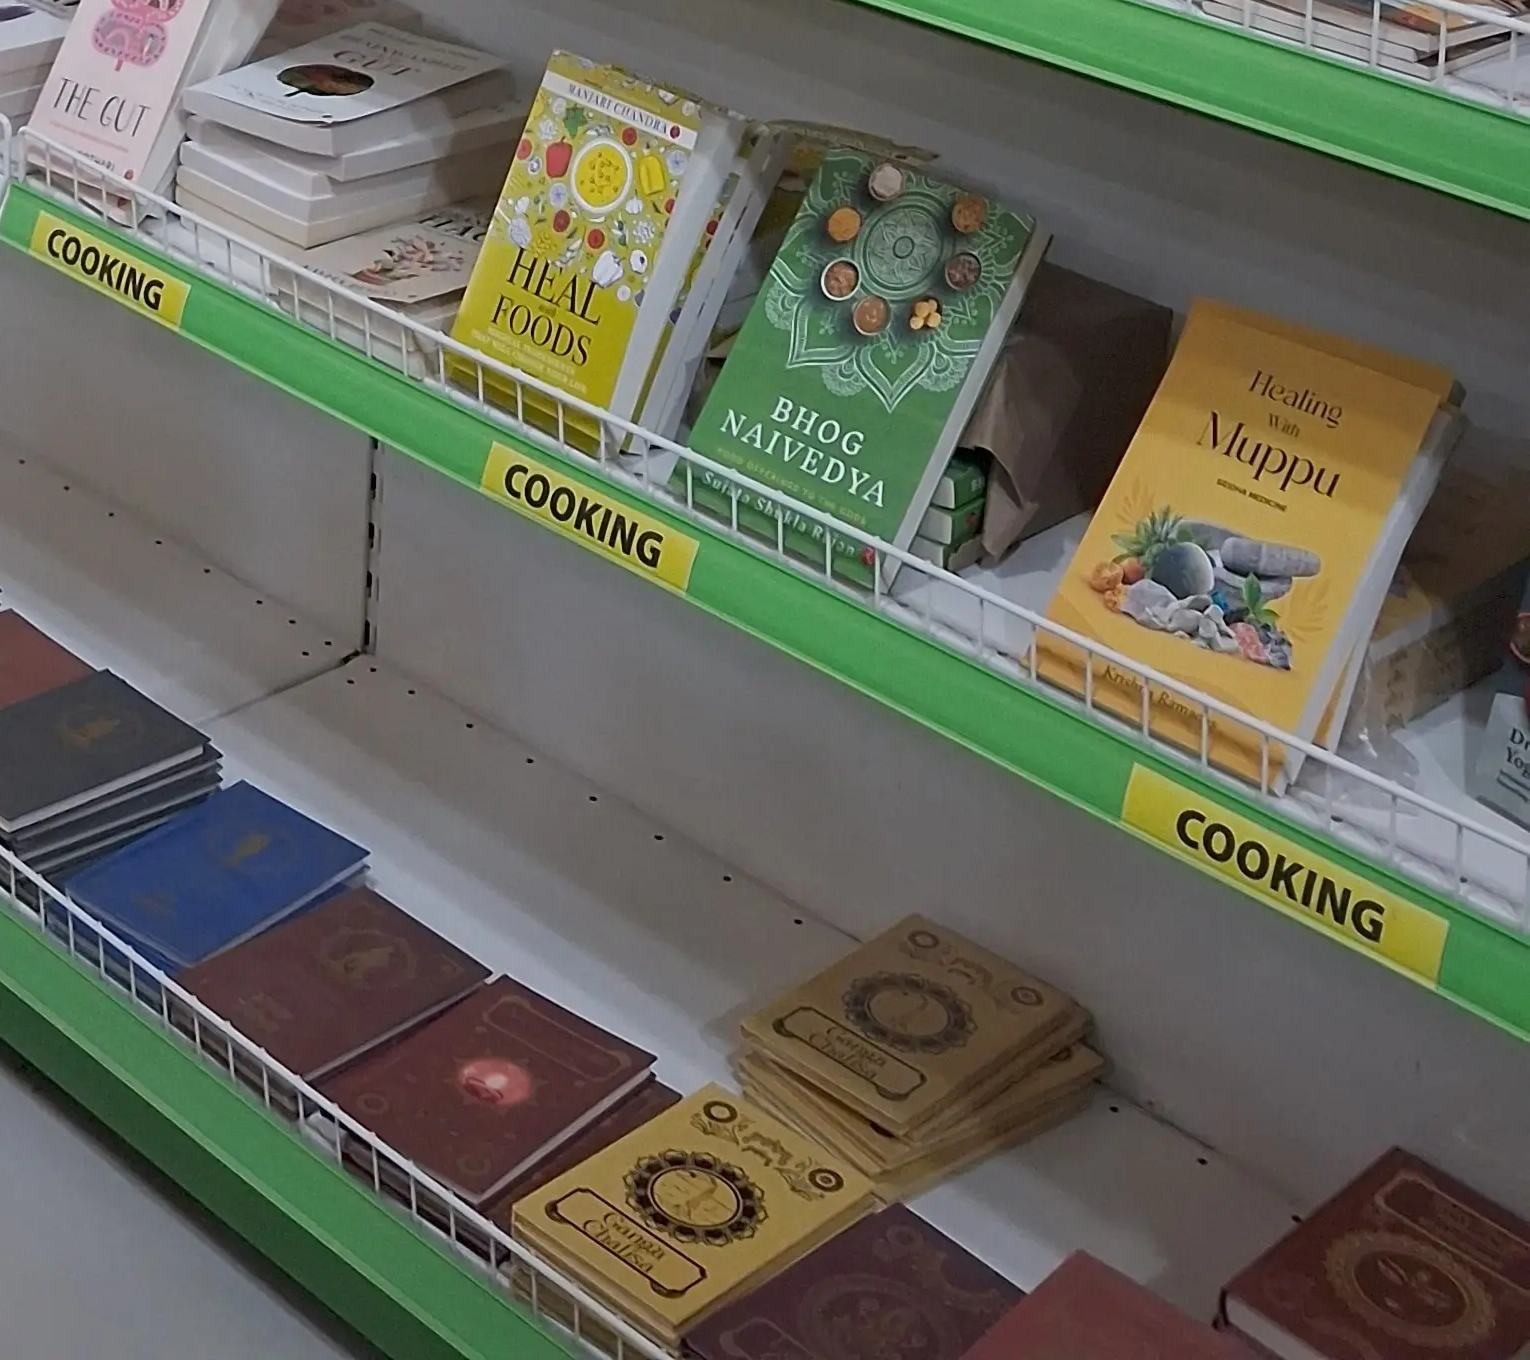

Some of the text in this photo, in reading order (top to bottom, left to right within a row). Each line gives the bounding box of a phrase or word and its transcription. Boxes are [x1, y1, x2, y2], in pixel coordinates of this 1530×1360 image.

[53, 77, 151, 138] THE GUT
[569, 83, 669, 134] MANJARI CHANDRA
[47, 229, 165, 311] COOKING
[506, 247, 601, 326] HEAL
[490, 295, 592, 367] FOODS
[770, 395, 865, 457] BHOG
[1247, 369, 1344, 430] Healing
[1267, 412, 1300, 439] With
[720, 408, 887, 508] NAIVEDYA
[1196, 411, 1341, 499] Muppu
[504, 464, 664, 568] COOKING
[1176, 810, 1385, 943] COOKING
[582, 1219, 653, 1273] Chalisa
